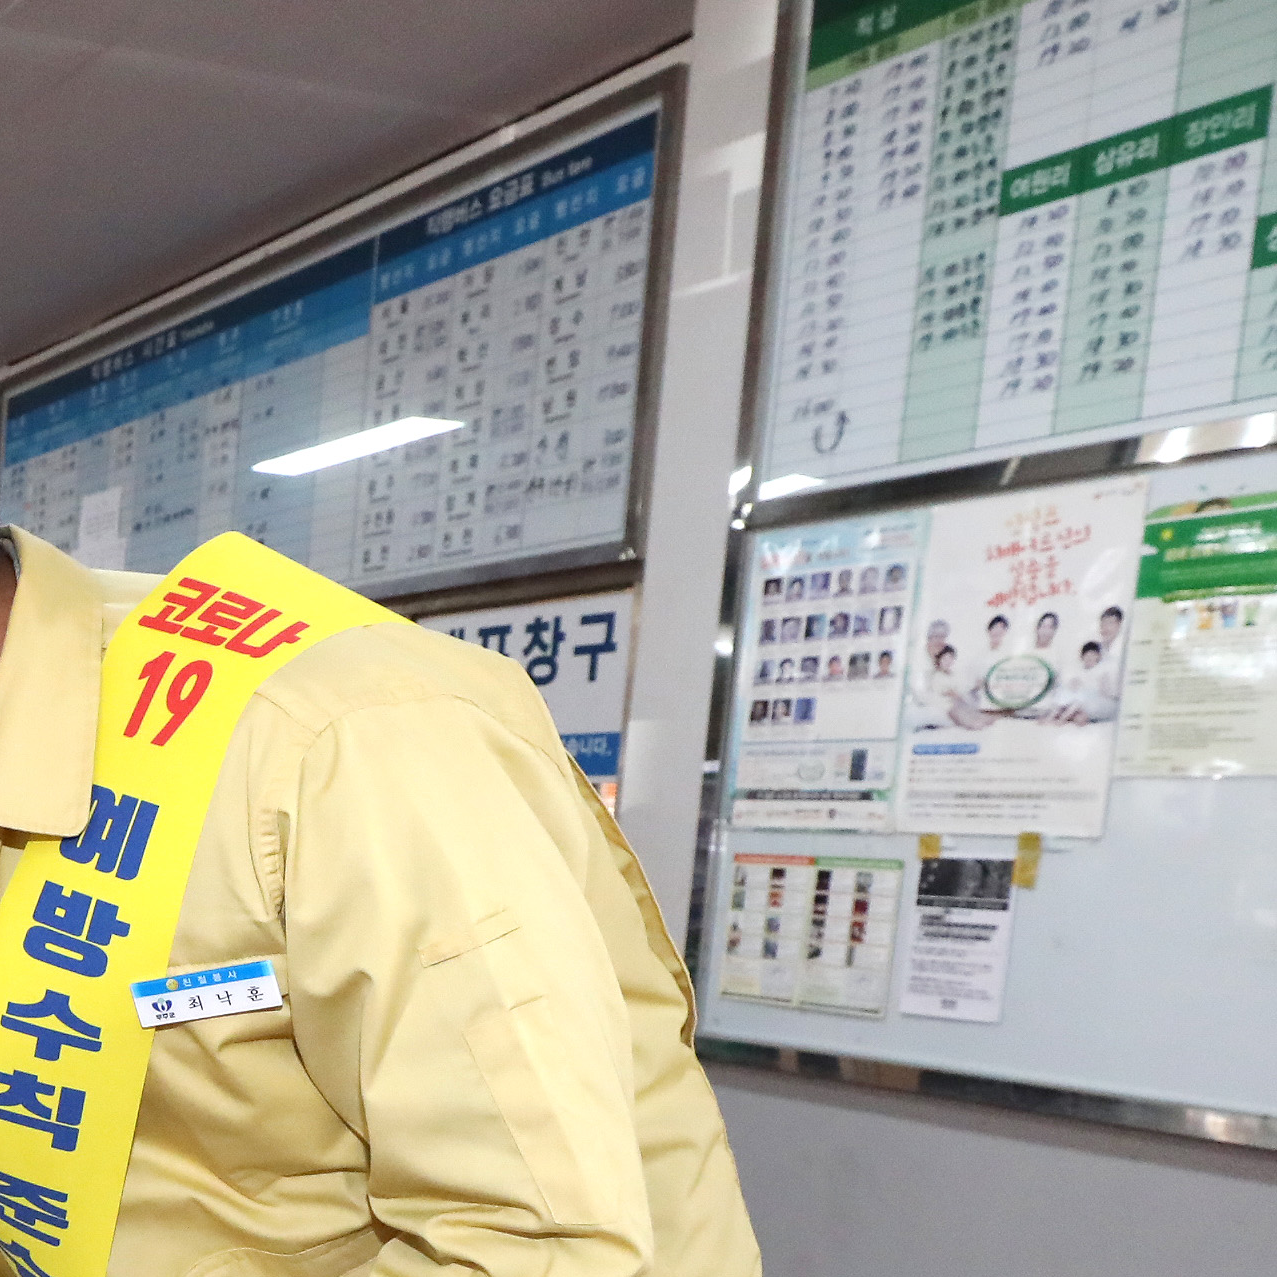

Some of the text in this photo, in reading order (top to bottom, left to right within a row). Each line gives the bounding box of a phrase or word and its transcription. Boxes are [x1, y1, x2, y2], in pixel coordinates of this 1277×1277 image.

[137, 576, 310, 661] 코로나
[122, 650, 216, 747] 19
[188, 985, 265, 1012] 최낙훈
